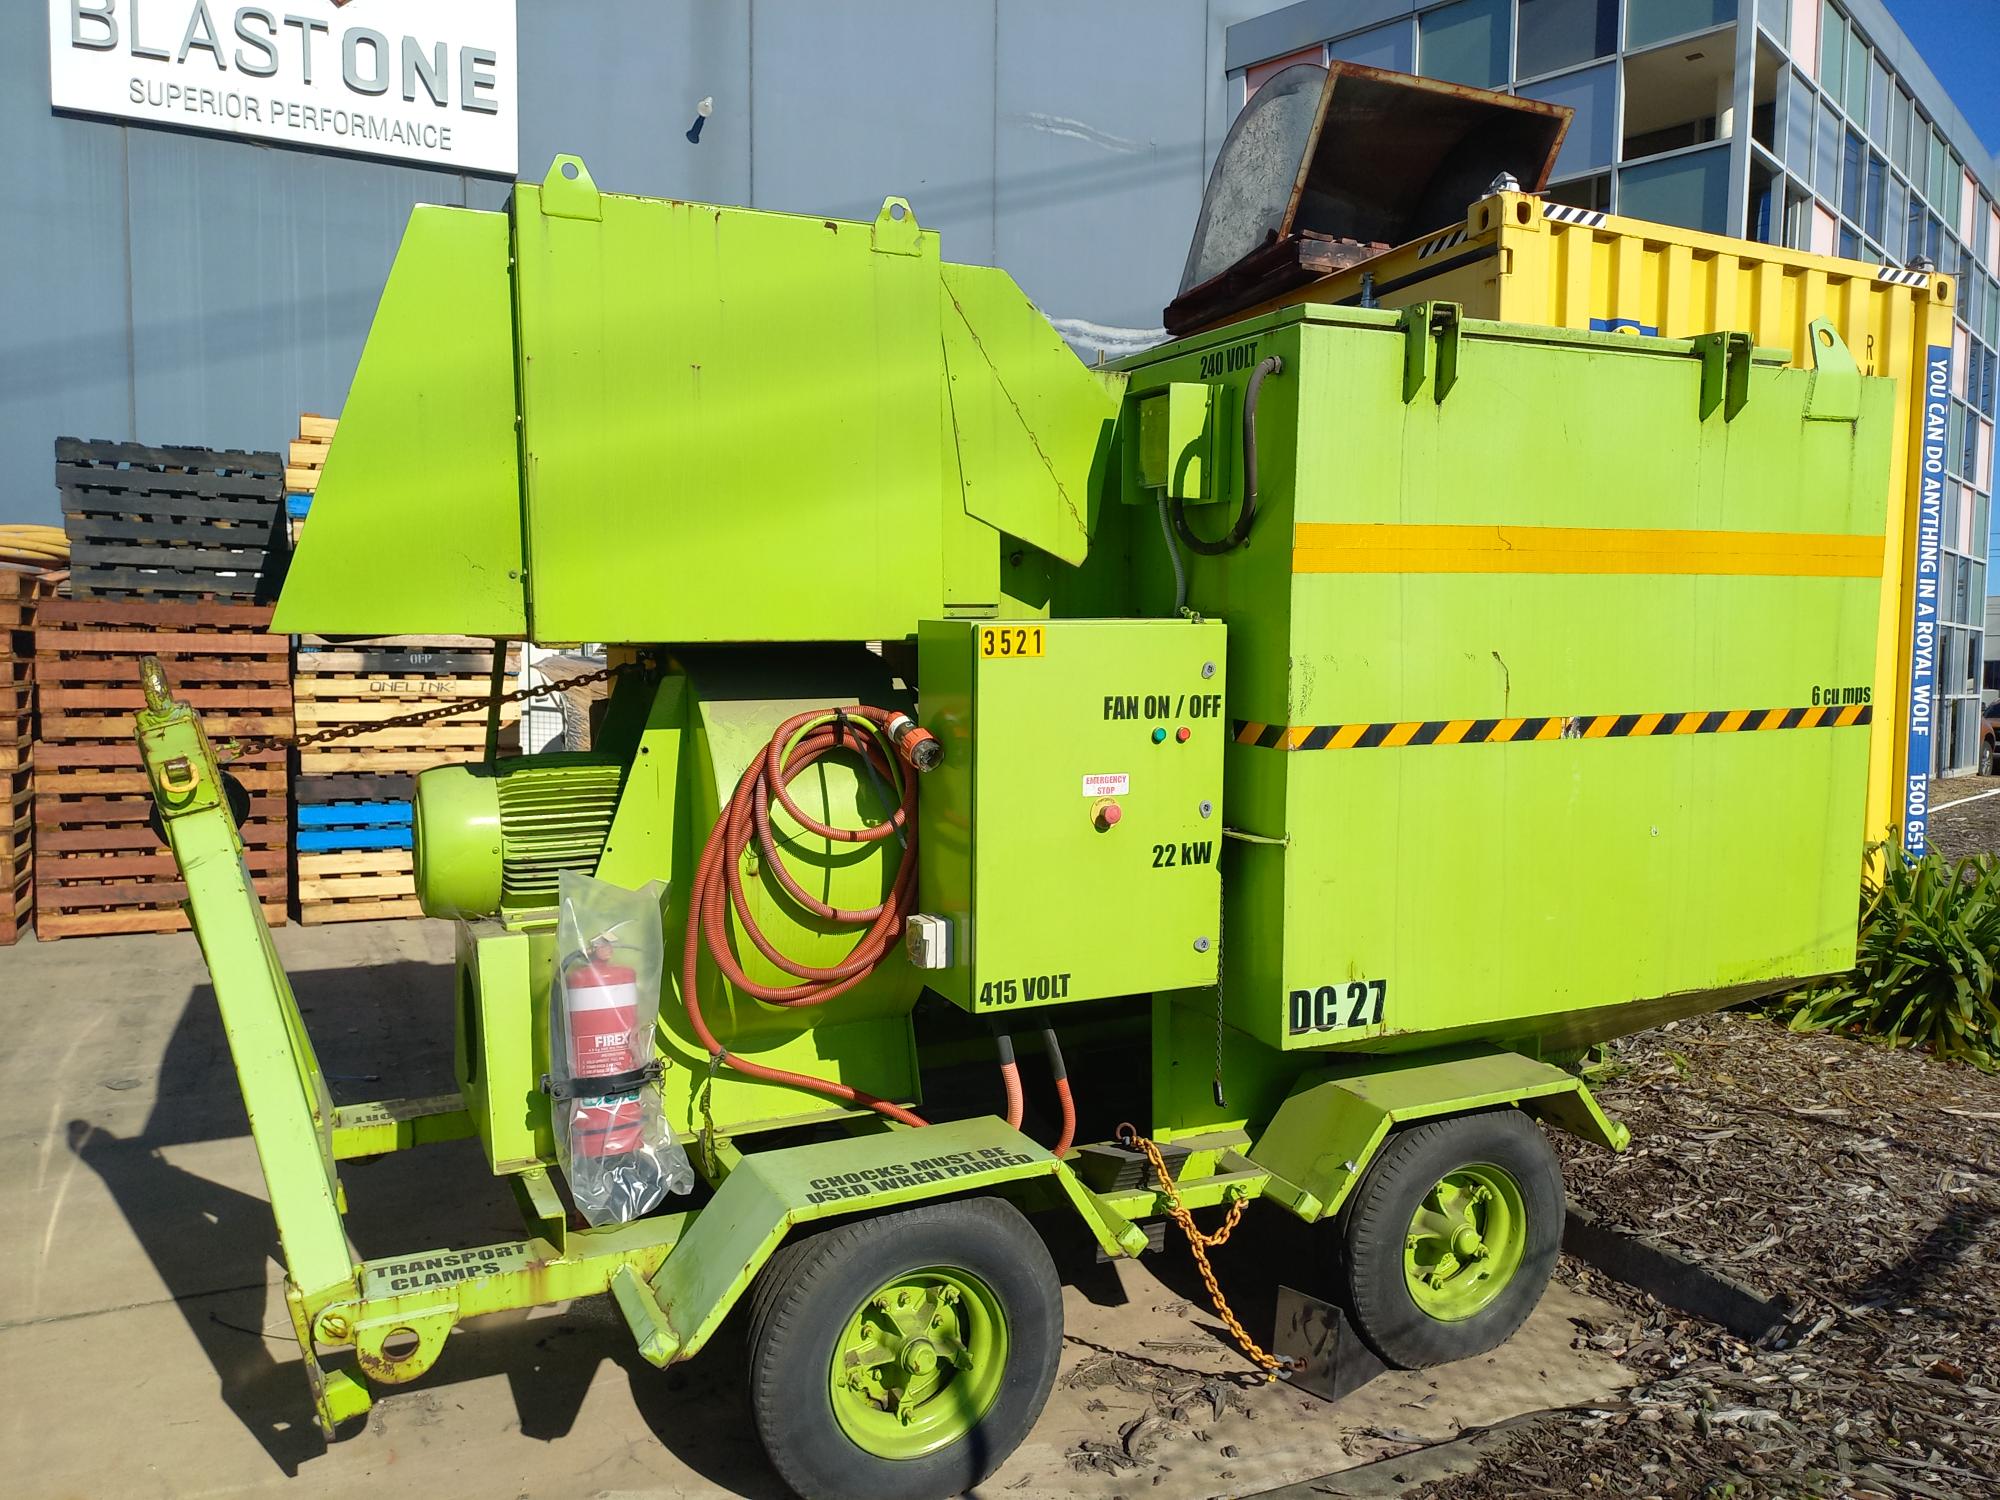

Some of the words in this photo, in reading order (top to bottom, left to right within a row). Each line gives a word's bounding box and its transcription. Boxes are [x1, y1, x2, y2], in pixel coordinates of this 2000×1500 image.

[71, 0, 498, 115] BLASTONE
[129, 77, 262, 122] SUPERIOR
[270, 99, 452, 151] PERFORMANCE
[1200, 351, 1224, 380] 240
[1226, 341, 1258, 373] VOLT
[1929, 359, 1948, 399] YOU
[1927, 403, 1946, 441] CAN
[1925, 445, 1942, 474] DO
[1919, 477, 1942, 573] ANYTHING
[1918, 578, 1936, 599] IN
[1917, 602, 1935, 617] A
[983, 628, 1042, 656] 3521
[1914, 621, 1934, 680] ROYAL
[1103, 695, 1139, 721] FAN
[1144, 695, 1171, 720] ON
[1174, 694, 1186, 719] /
[1189, 694, 1222, 719] OFF
[1811, 685, 1821, 706] 6
[1823, 688, 1840, 706] cu
[1842, 686, 1872, 706] mps
[1911, 684, 1931, 736] WOLF
[1085, 775, 1127, 785] EMERGENCY
[1096, 786, 1116, 795] STOP
[1909, 772, 1927, 816] 1300
[1152, 843, 1177, 869] 22
[1181, 841, 1213, 866] kW
[979, 979, 1018, 1006] 415
[1022, 973, 1072, 1002] VOLT
[1289, 985, 1337, 1036] DC
[1346, 979, 1387, 1028] 27
[805, 1184, 872, 1205] USED
[873, 1168, 946, 1192] WHEN
[945, 1153, 1035, 1177] PARKED
[809, 1164, 909, 1191] CHOCKS
[908, 1151, 977, 1172] MUST
[978, 1146, 1011, 1159] BE
[373, 1243, 527, 1278] TRANSPORT
[390, 1262, 501, 1291] CLAMPS
